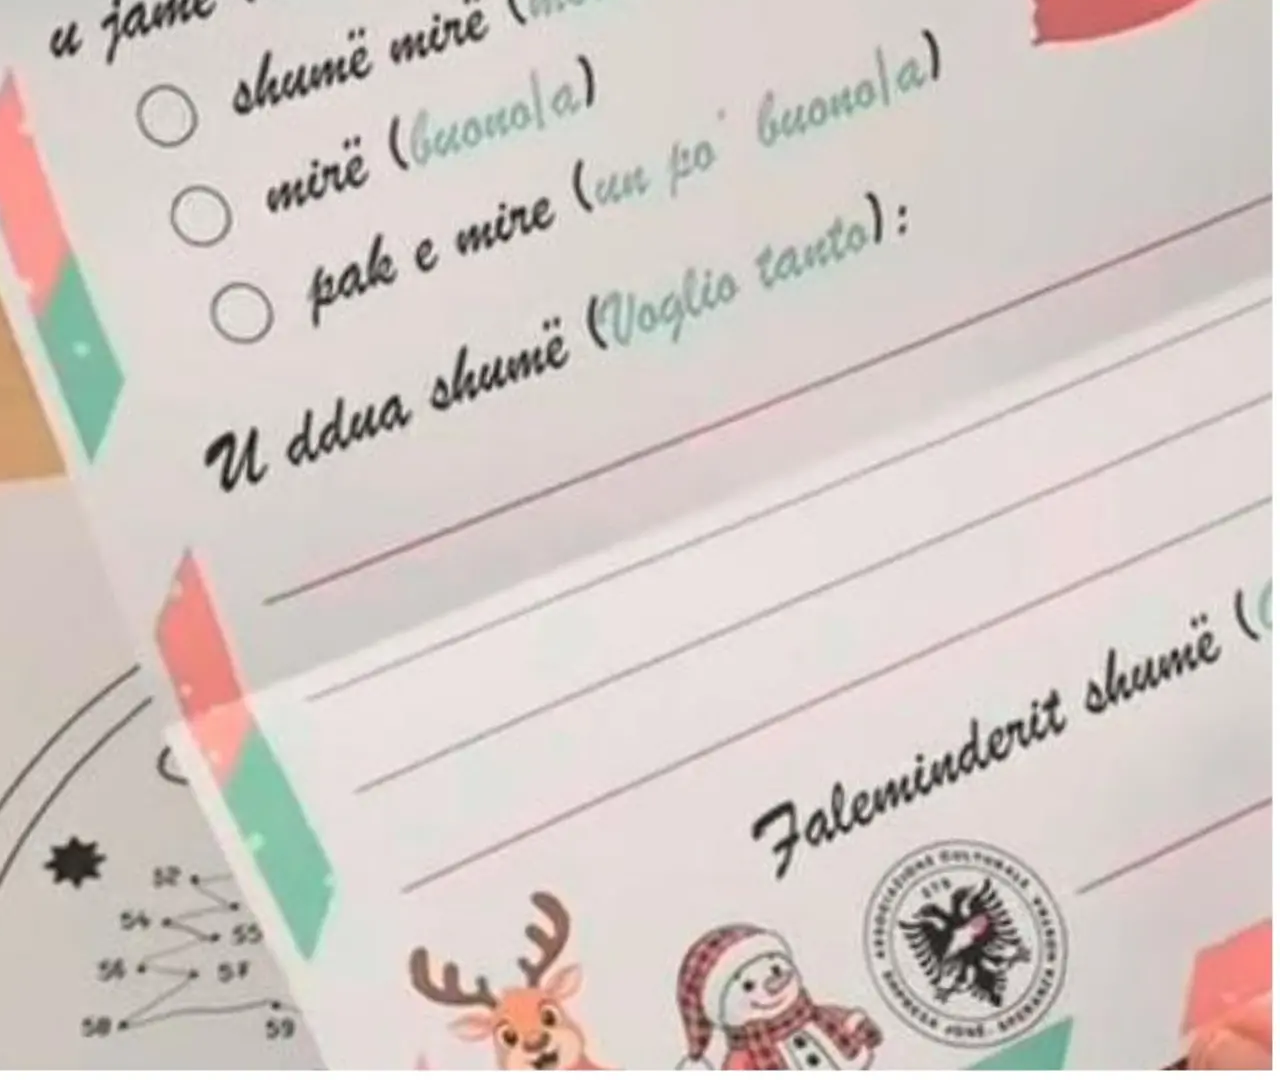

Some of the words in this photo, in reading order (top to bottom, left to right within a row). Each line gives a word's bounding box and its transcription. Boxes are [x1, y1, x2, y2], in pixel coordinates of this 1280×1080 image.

[49, 19, 83, 59] u
[232, 27, 373, 115] shumë
[266, 136, 371, 215] mirë
[307, 233, 399, 328] pak
[414, 237, 439, 272] e
[454, 195, 558, 258] mire
[573, 158, 652, 214] (un
[203, 427, 269, 494] U
[285, 395, 412, 466] ddua
[429, 317, 571, 411] shumë
[586, 266, 739, 350] (Voglio
[755, 191, 907, 288] tanto):
[751, 687, 1069, 881] Faleminderit
[1084, 612, 1223, 714] shumë
[151, 866, 183, 887] 52
[119, 910, 151, 931] 54
[264, 1017, 297, 1040] 59
